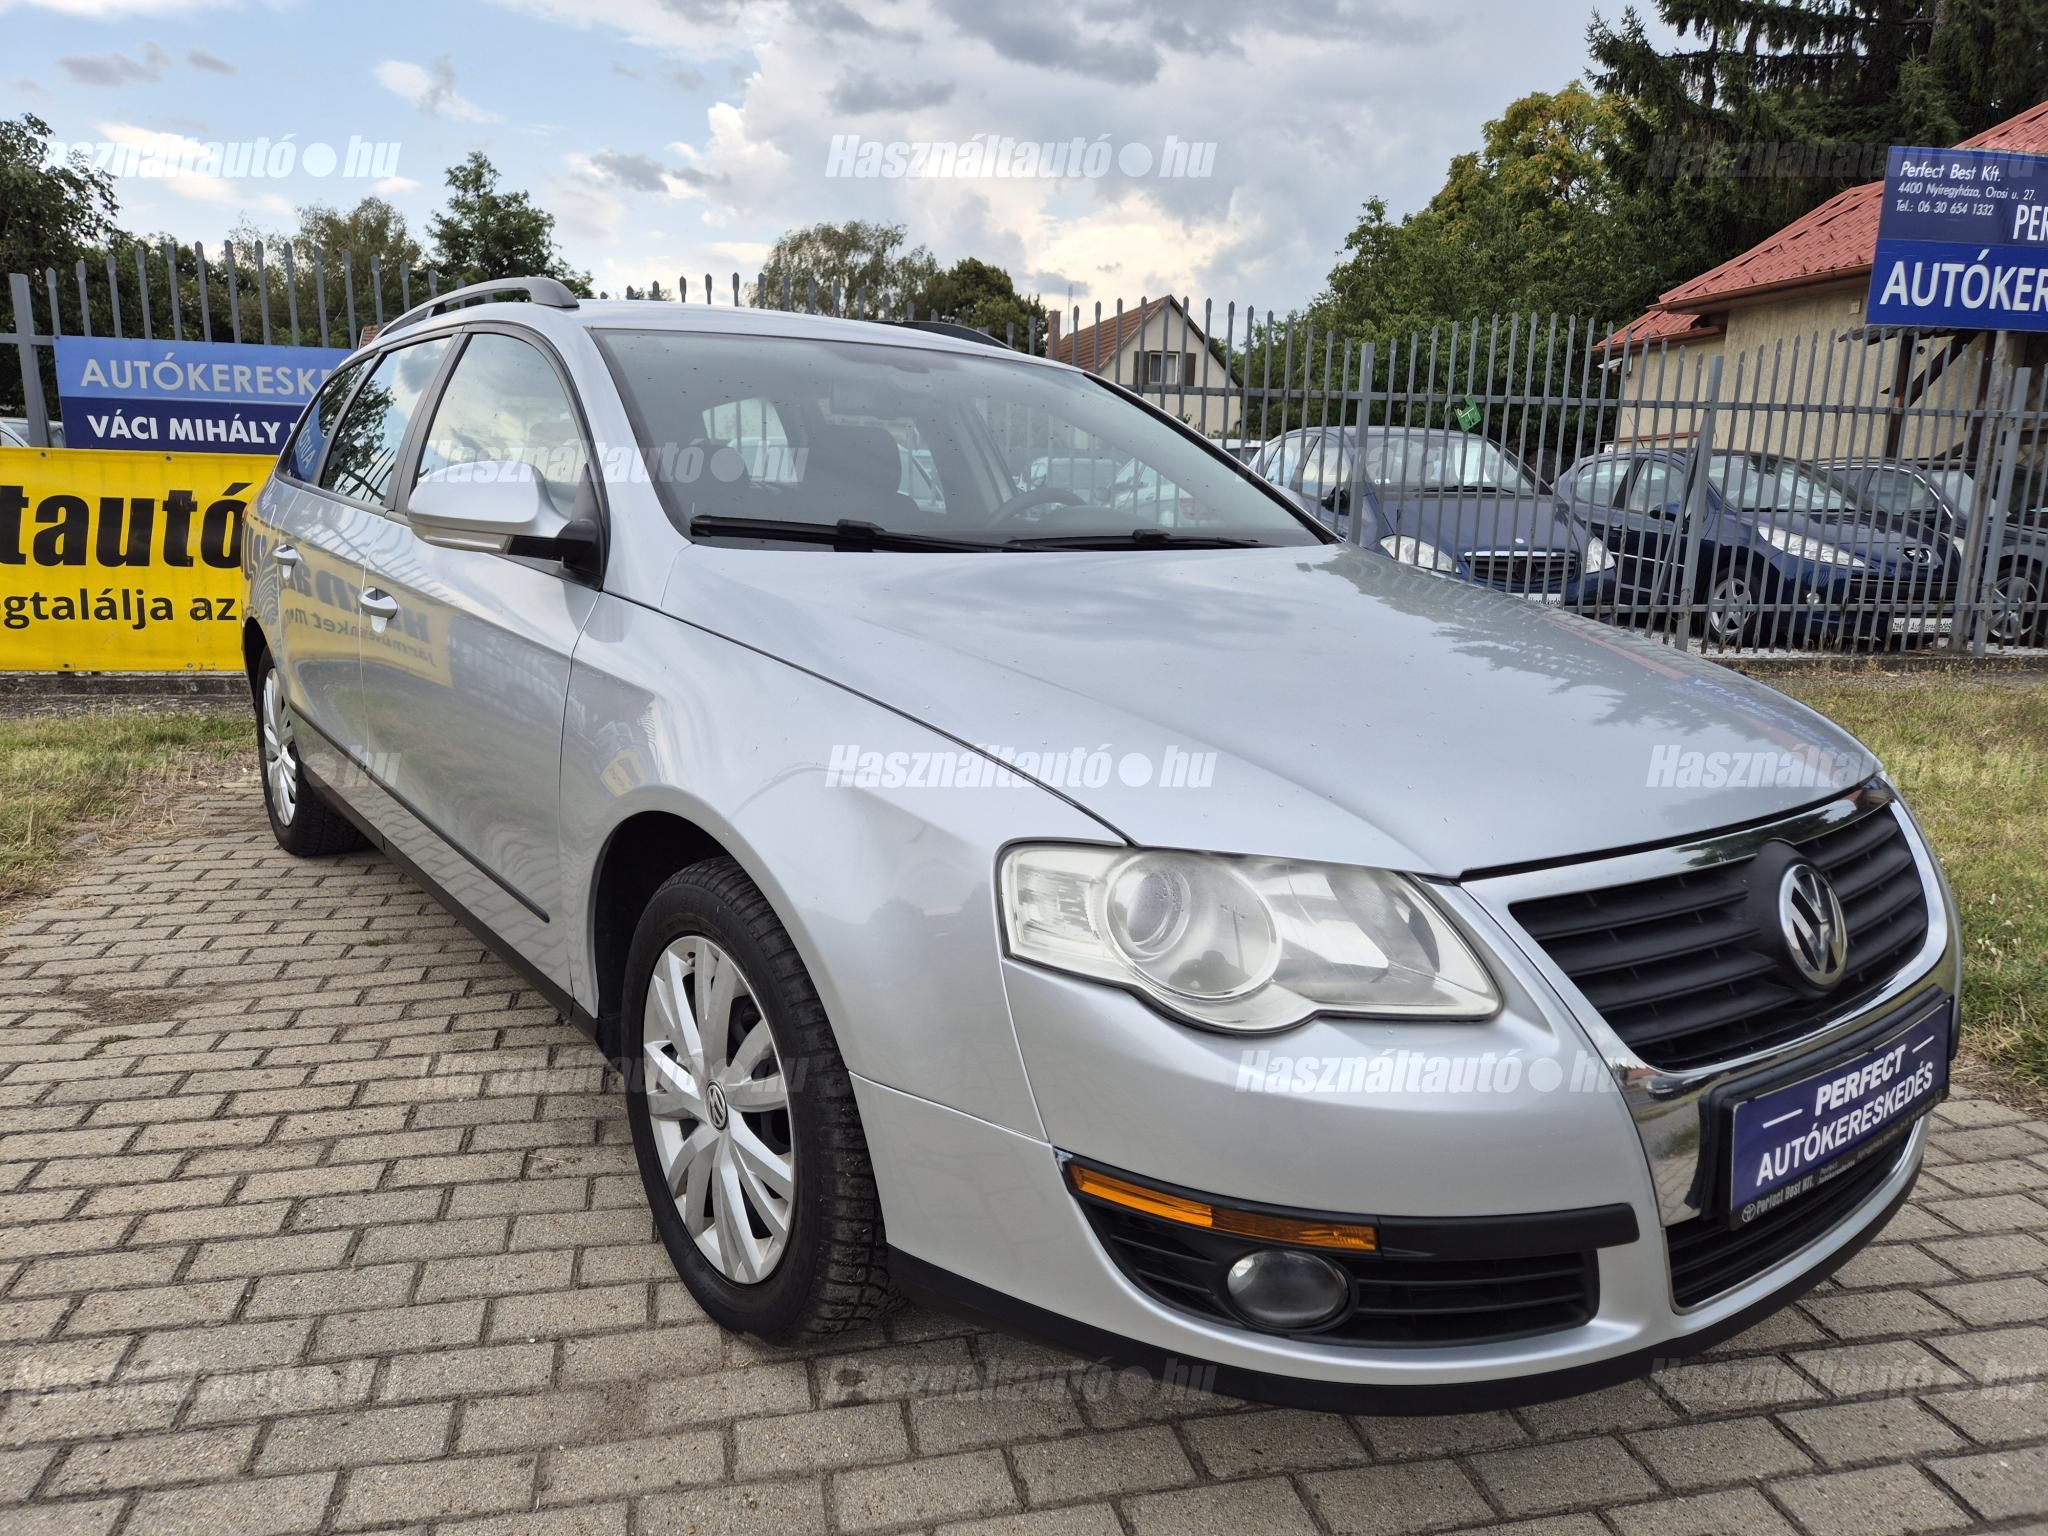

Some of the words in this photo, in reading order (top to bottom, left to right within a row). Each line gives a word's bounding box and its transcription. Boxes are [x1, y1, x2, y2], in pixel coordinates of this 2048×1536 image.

[1899, 160, 1945, 178] Perfect
[1949, 163, 1977, 181] Best
[1981, 165, 2001, 182] Kft.
[1897, 182, 1923, 194] 4400
[1926, 183, 1981, 199] Nyíregyháza,
[2011, 191, 2019, 200] u.
[2023, 189, 2036, 201] 27.
[1896, 199, 1914, 212] Tel.:
[1917, 200, 1931, 213] 06
[1933, 201, 1947, 213] 30
[1949, 202, 1968, 214] 654
[1972, 203, 1994, 216] 1332
[1879, 248, 2048, 312] AUTÓKER
[87, 408, 158, 440] VÁCI
[169, 413, 281, 444] MIHÁLY
[189, 597, 237, 621] az
[1814, 1043, 1907, 1116] PERFECT
[1756, 1060, 1934, 1187] AUTÓKERESKEDÉS
